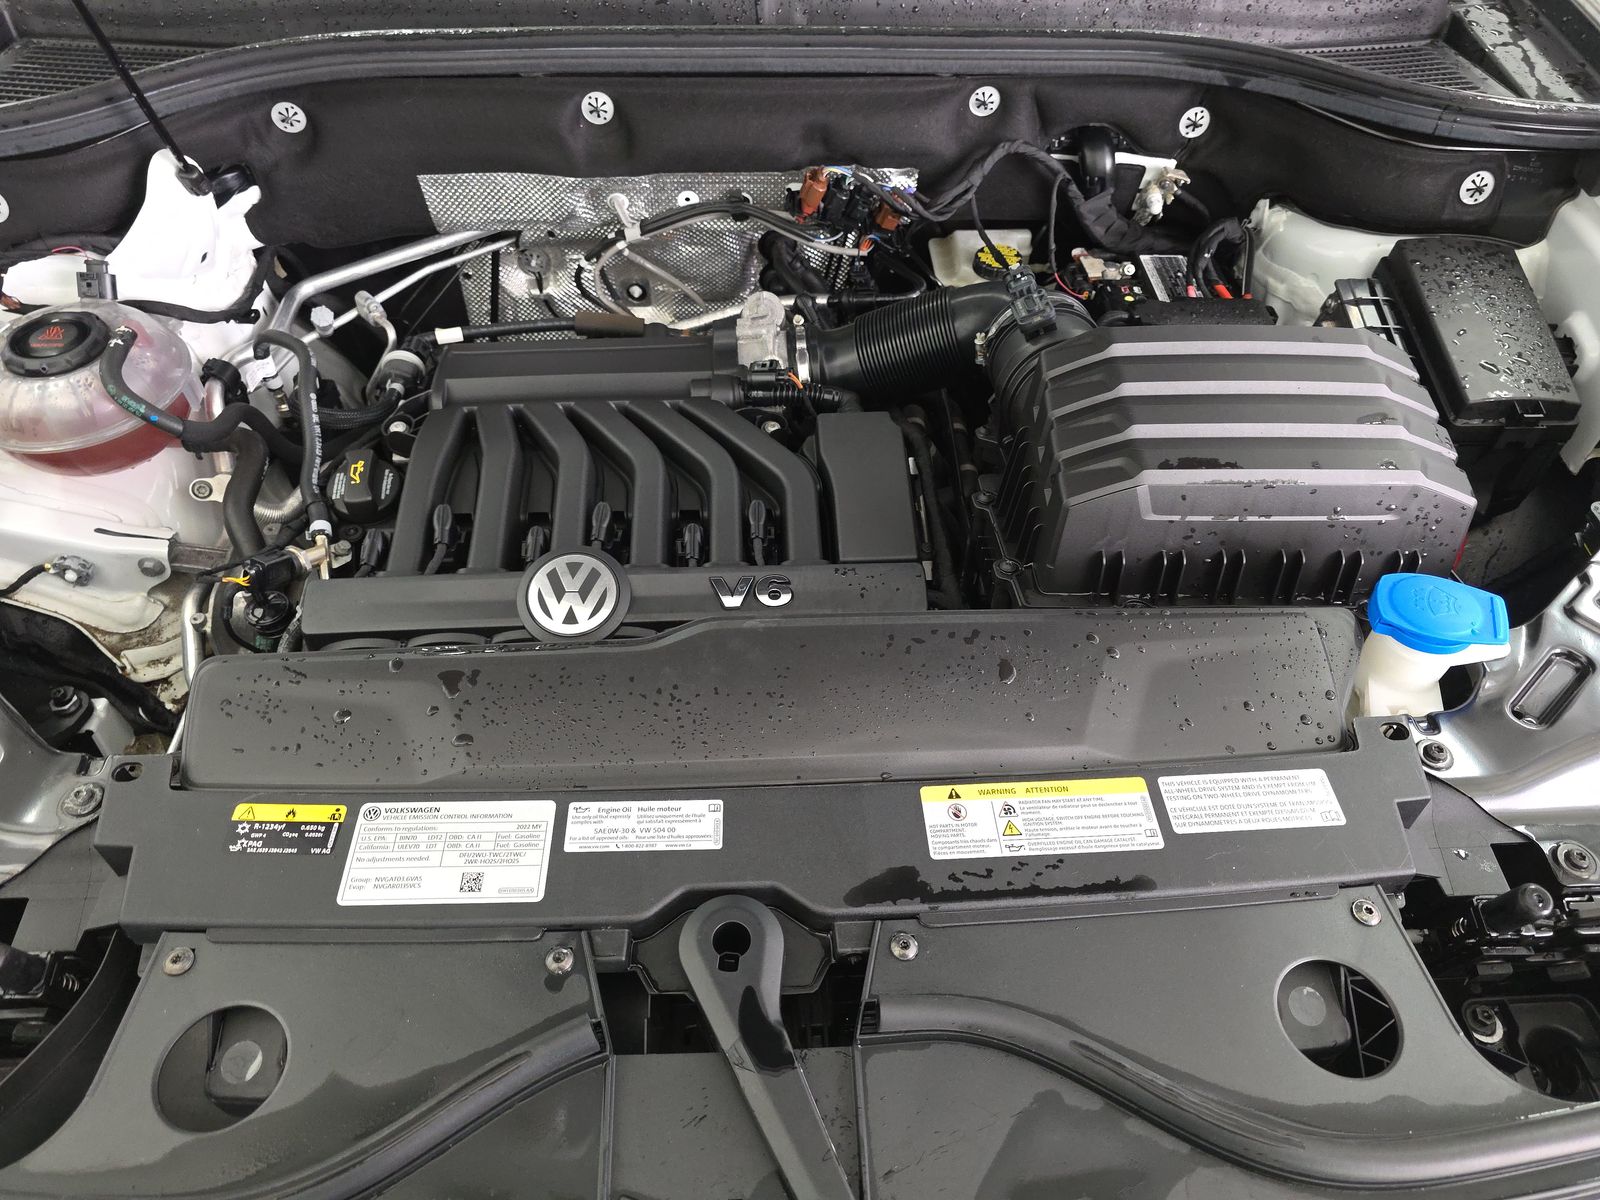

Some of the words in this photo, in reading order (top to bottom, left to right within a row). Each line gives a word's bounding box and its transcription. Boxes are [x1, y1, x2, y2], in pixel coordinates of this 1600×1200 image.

[709, 574, 792, 610] V6
[1025, 786, 1069, 794] ATTENTION
[254, 823, 286, 831] R-1234yf
[366, 856, 405, 864] adjustments
